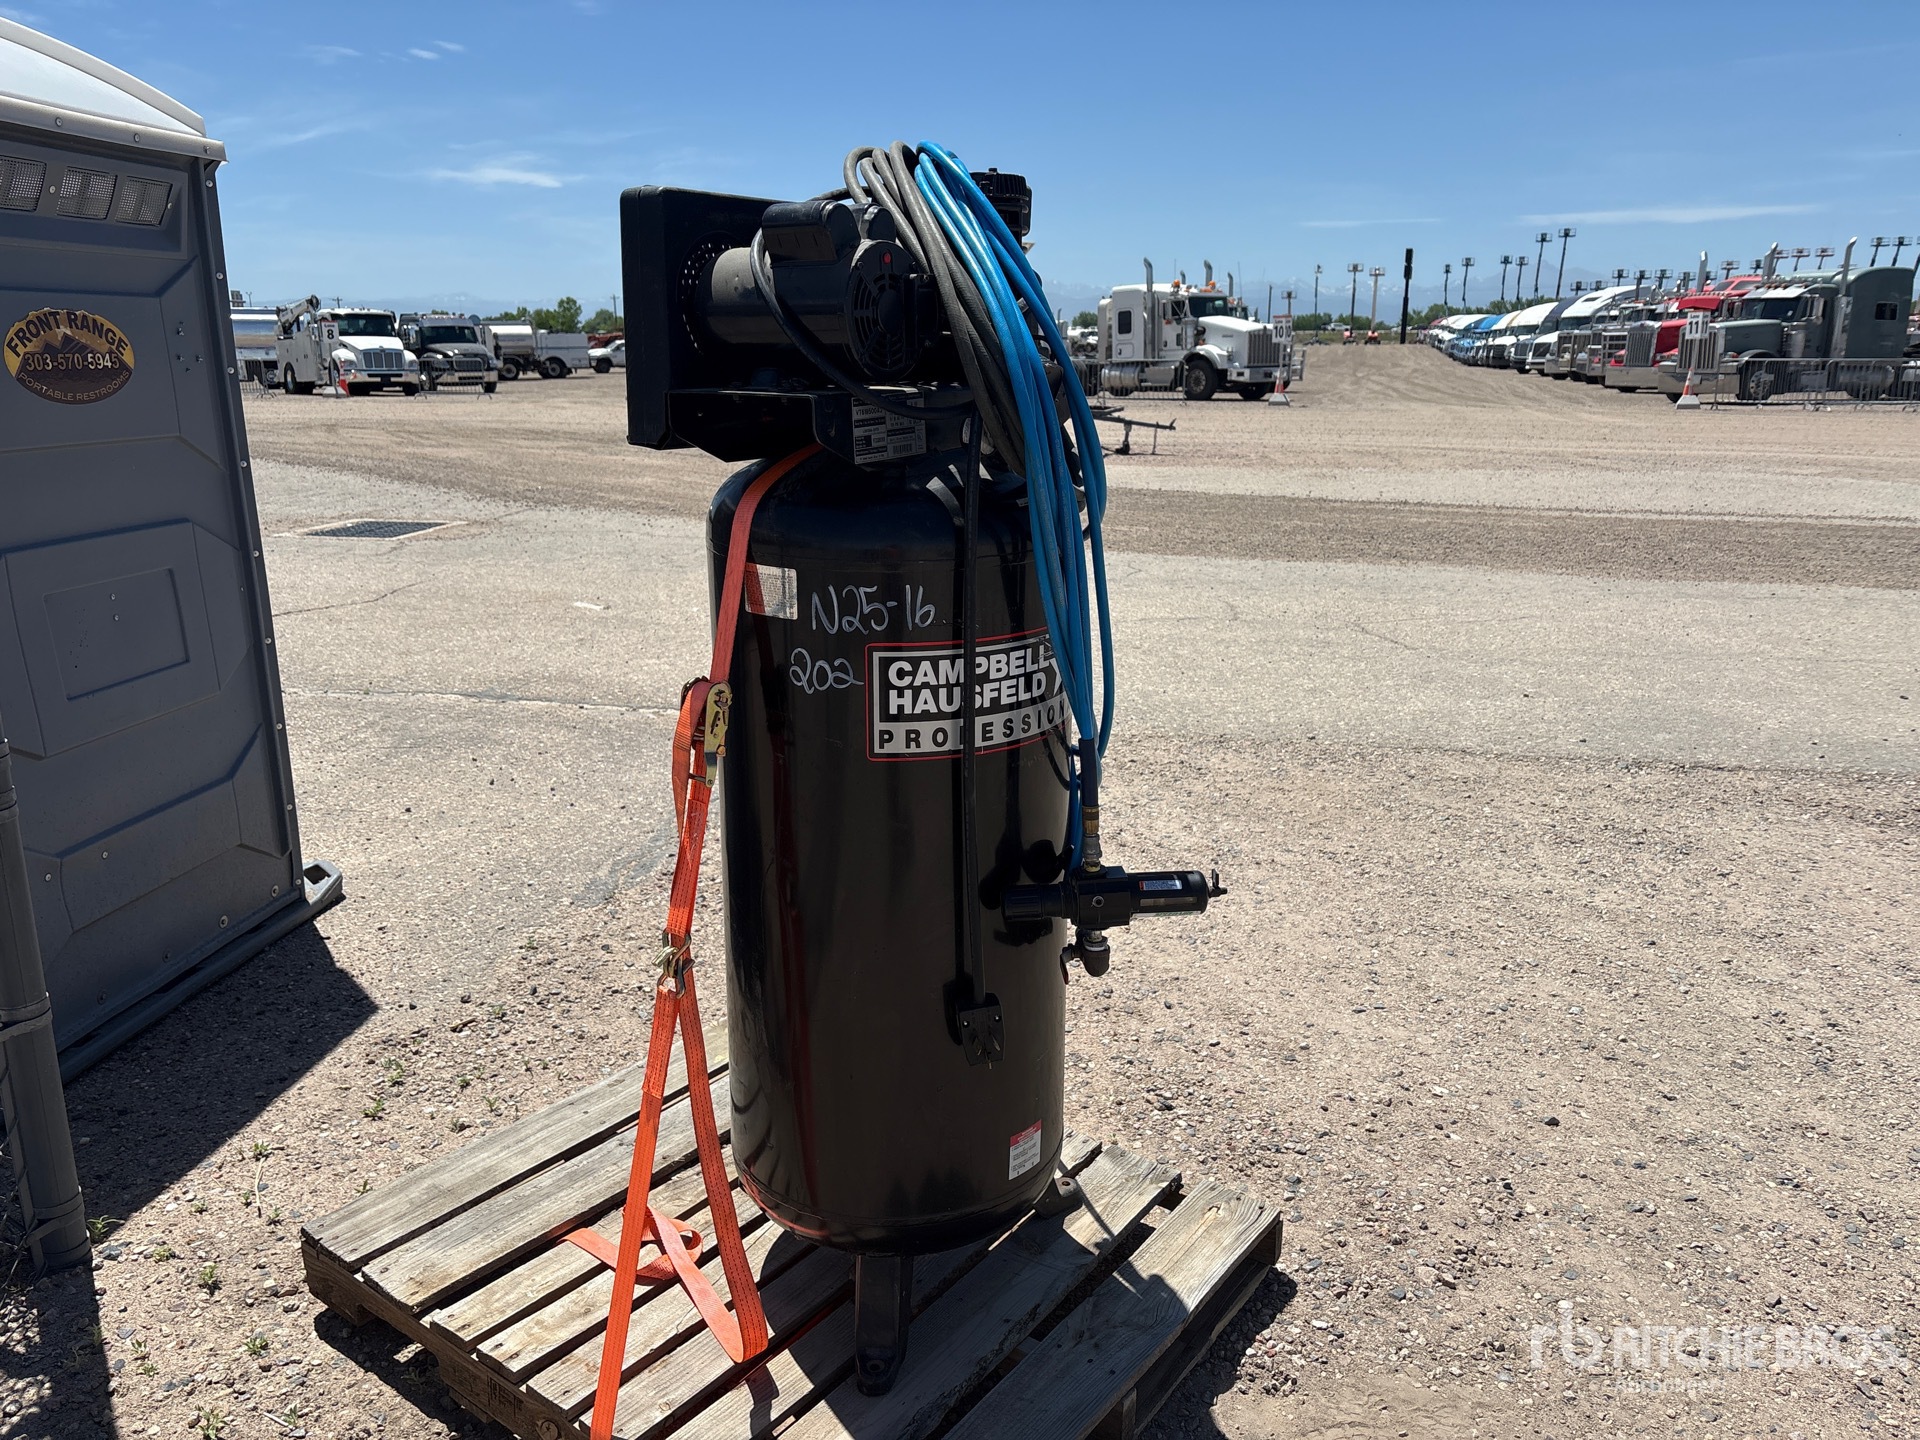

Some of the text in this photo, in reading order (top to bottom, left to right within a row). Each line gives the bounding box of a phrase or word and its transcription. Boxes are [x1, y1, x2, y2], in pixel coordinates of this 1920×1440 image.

[6, 311, 128, 358] FRONT RANGE
[327, 329, 334, 340] 8
[1274, 325, 1284, 338] 10
[24, 352, 120, 371] 303-570-5945
[18, 370, 130, 401] PORTABLE RESTROOMS
[811, 584, 936, 635] N25-16
[789, 647, 865, 695] 202
[888, 644, 1050, 688] CAMPBELL
